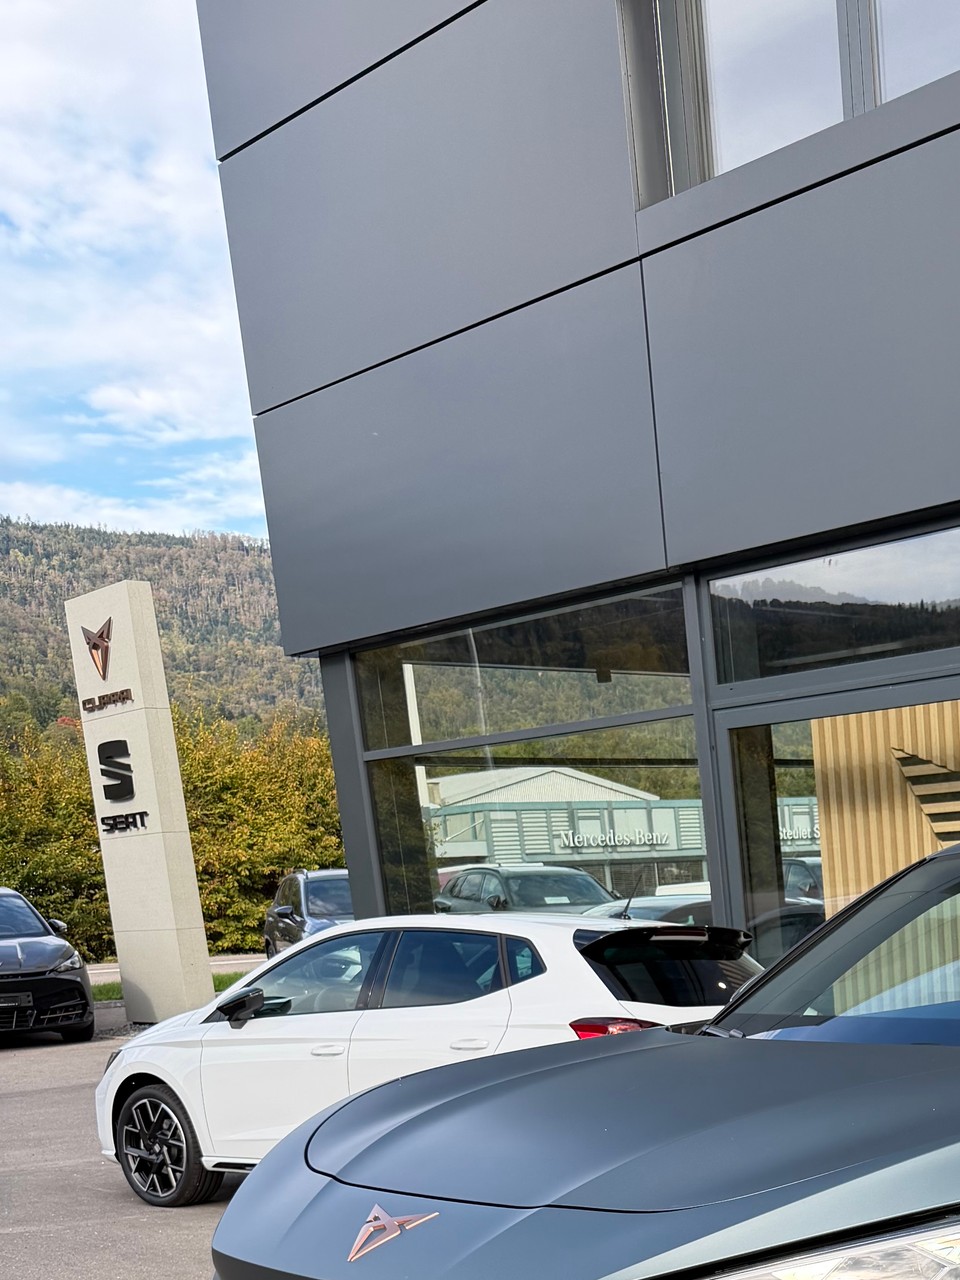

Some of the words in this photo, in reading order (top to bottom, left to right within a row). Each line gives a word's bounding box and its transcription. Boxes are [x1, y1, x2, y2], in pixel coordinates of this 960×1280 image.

[82, 689, 134, 712] CUPRA
[101, 811, 148, 832] SEAT
[561, 829, 669, 848] Mercedes-Benz
